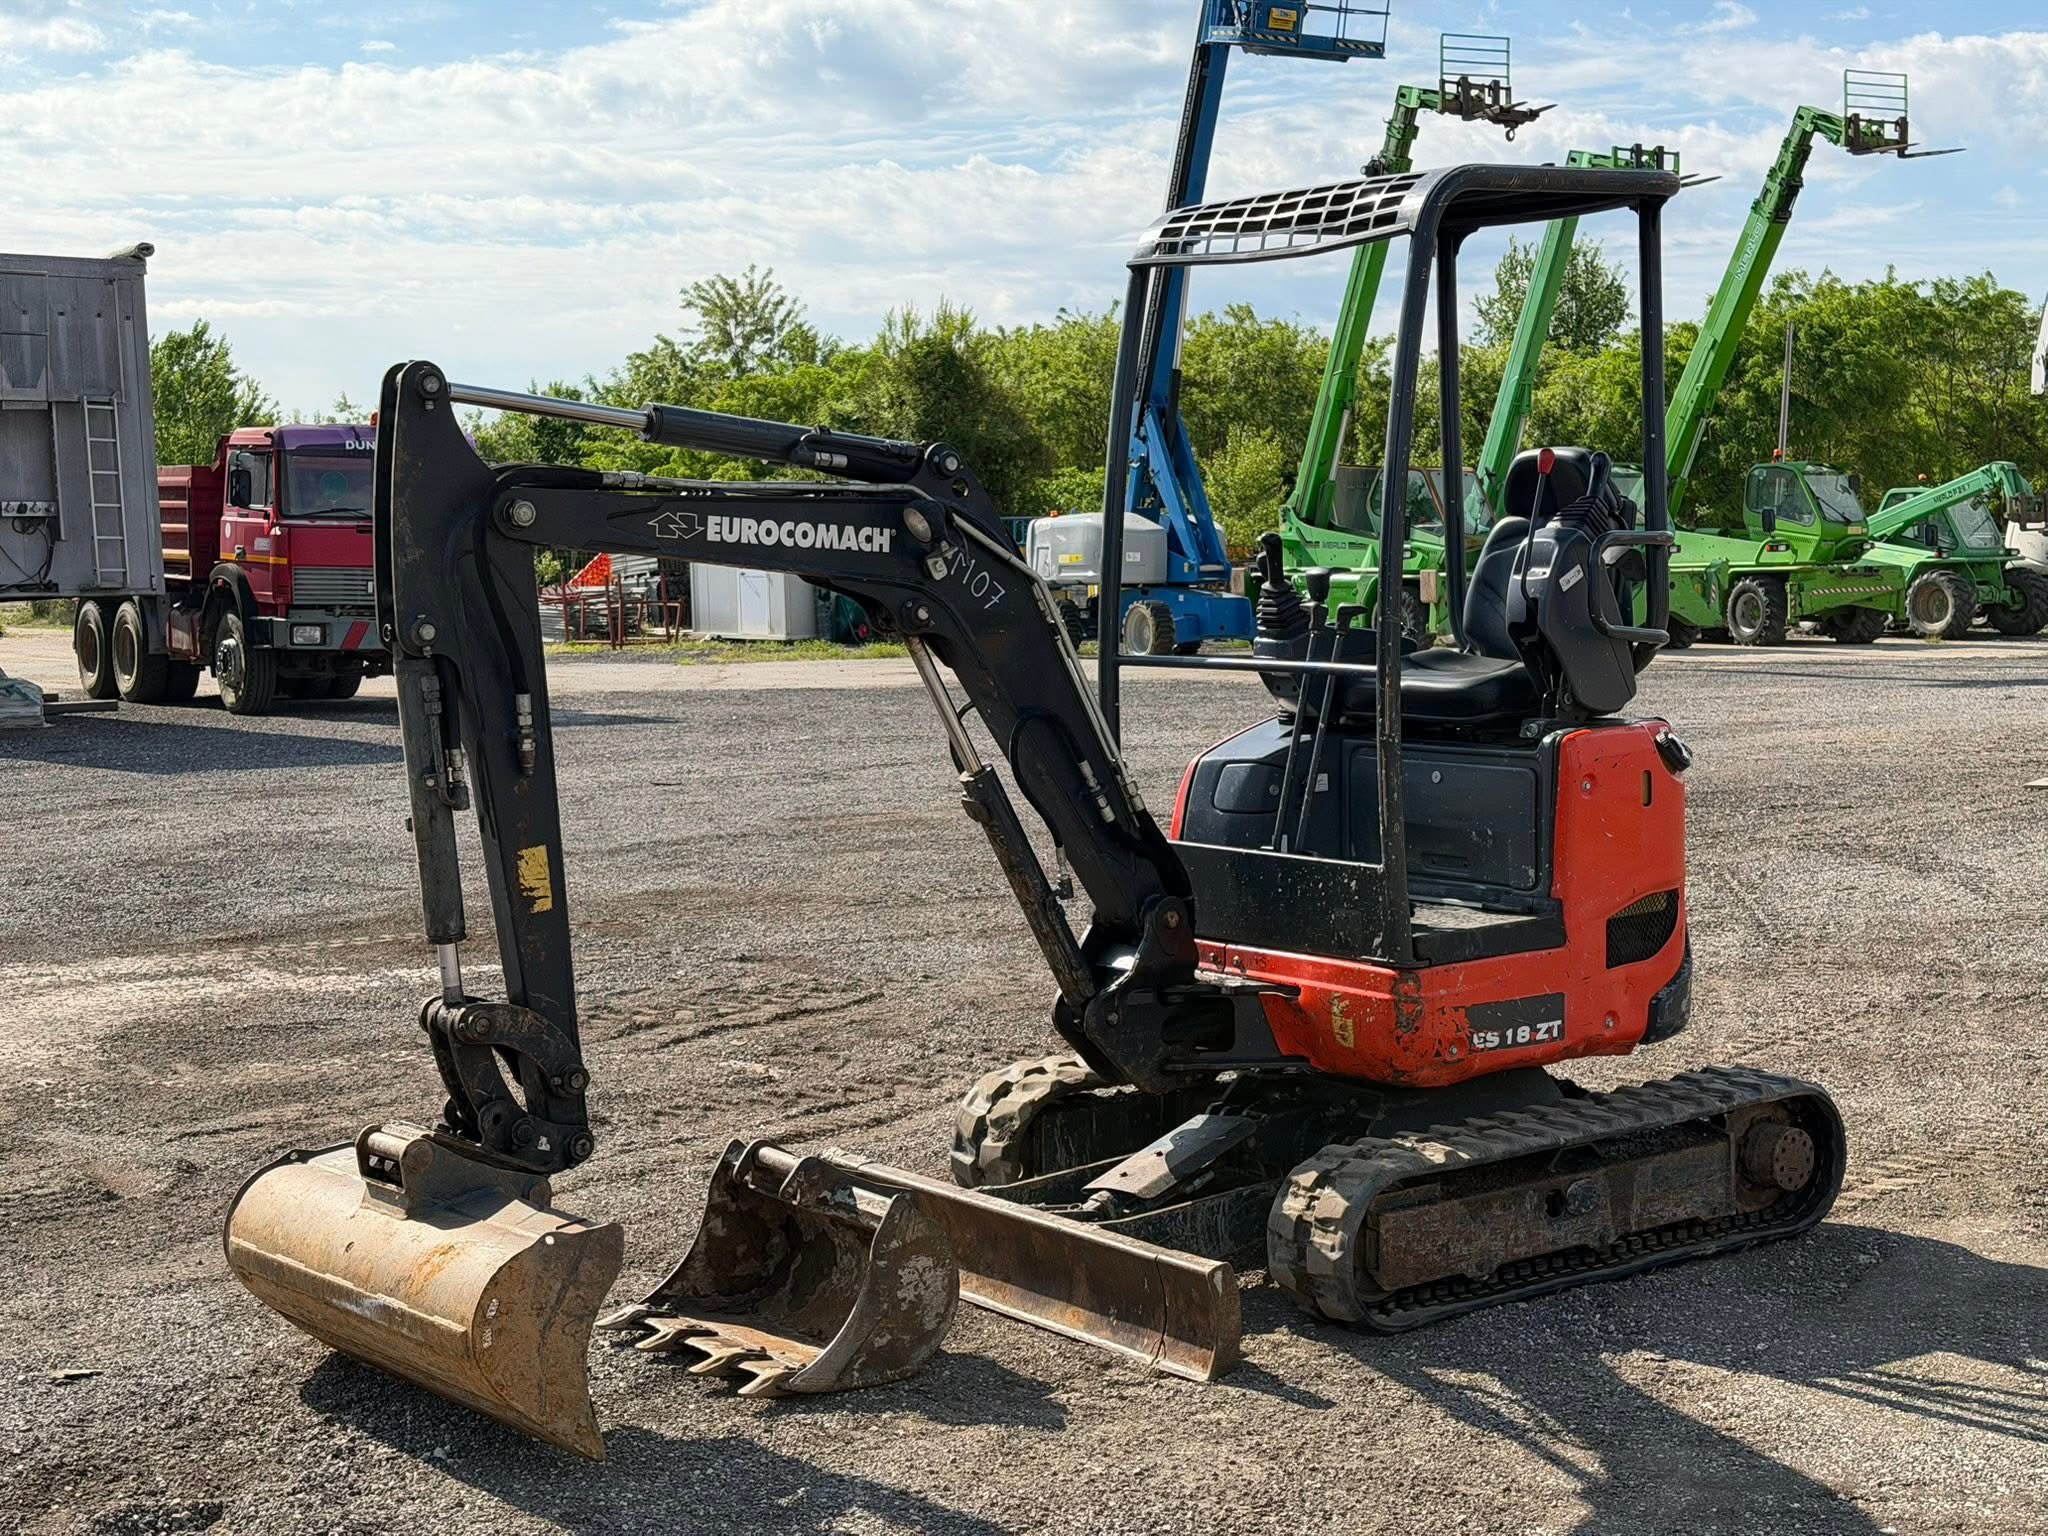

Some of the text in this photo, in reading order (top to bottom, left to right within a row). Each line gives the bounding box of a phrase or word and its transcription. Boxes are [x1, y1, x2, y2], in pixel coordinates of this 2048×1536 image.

[706, 515, 891, 553] EUROCOMACH
[1505, 1025, 1531, 1044] 18
[1535, 1020, 1562, 1041] ZT
